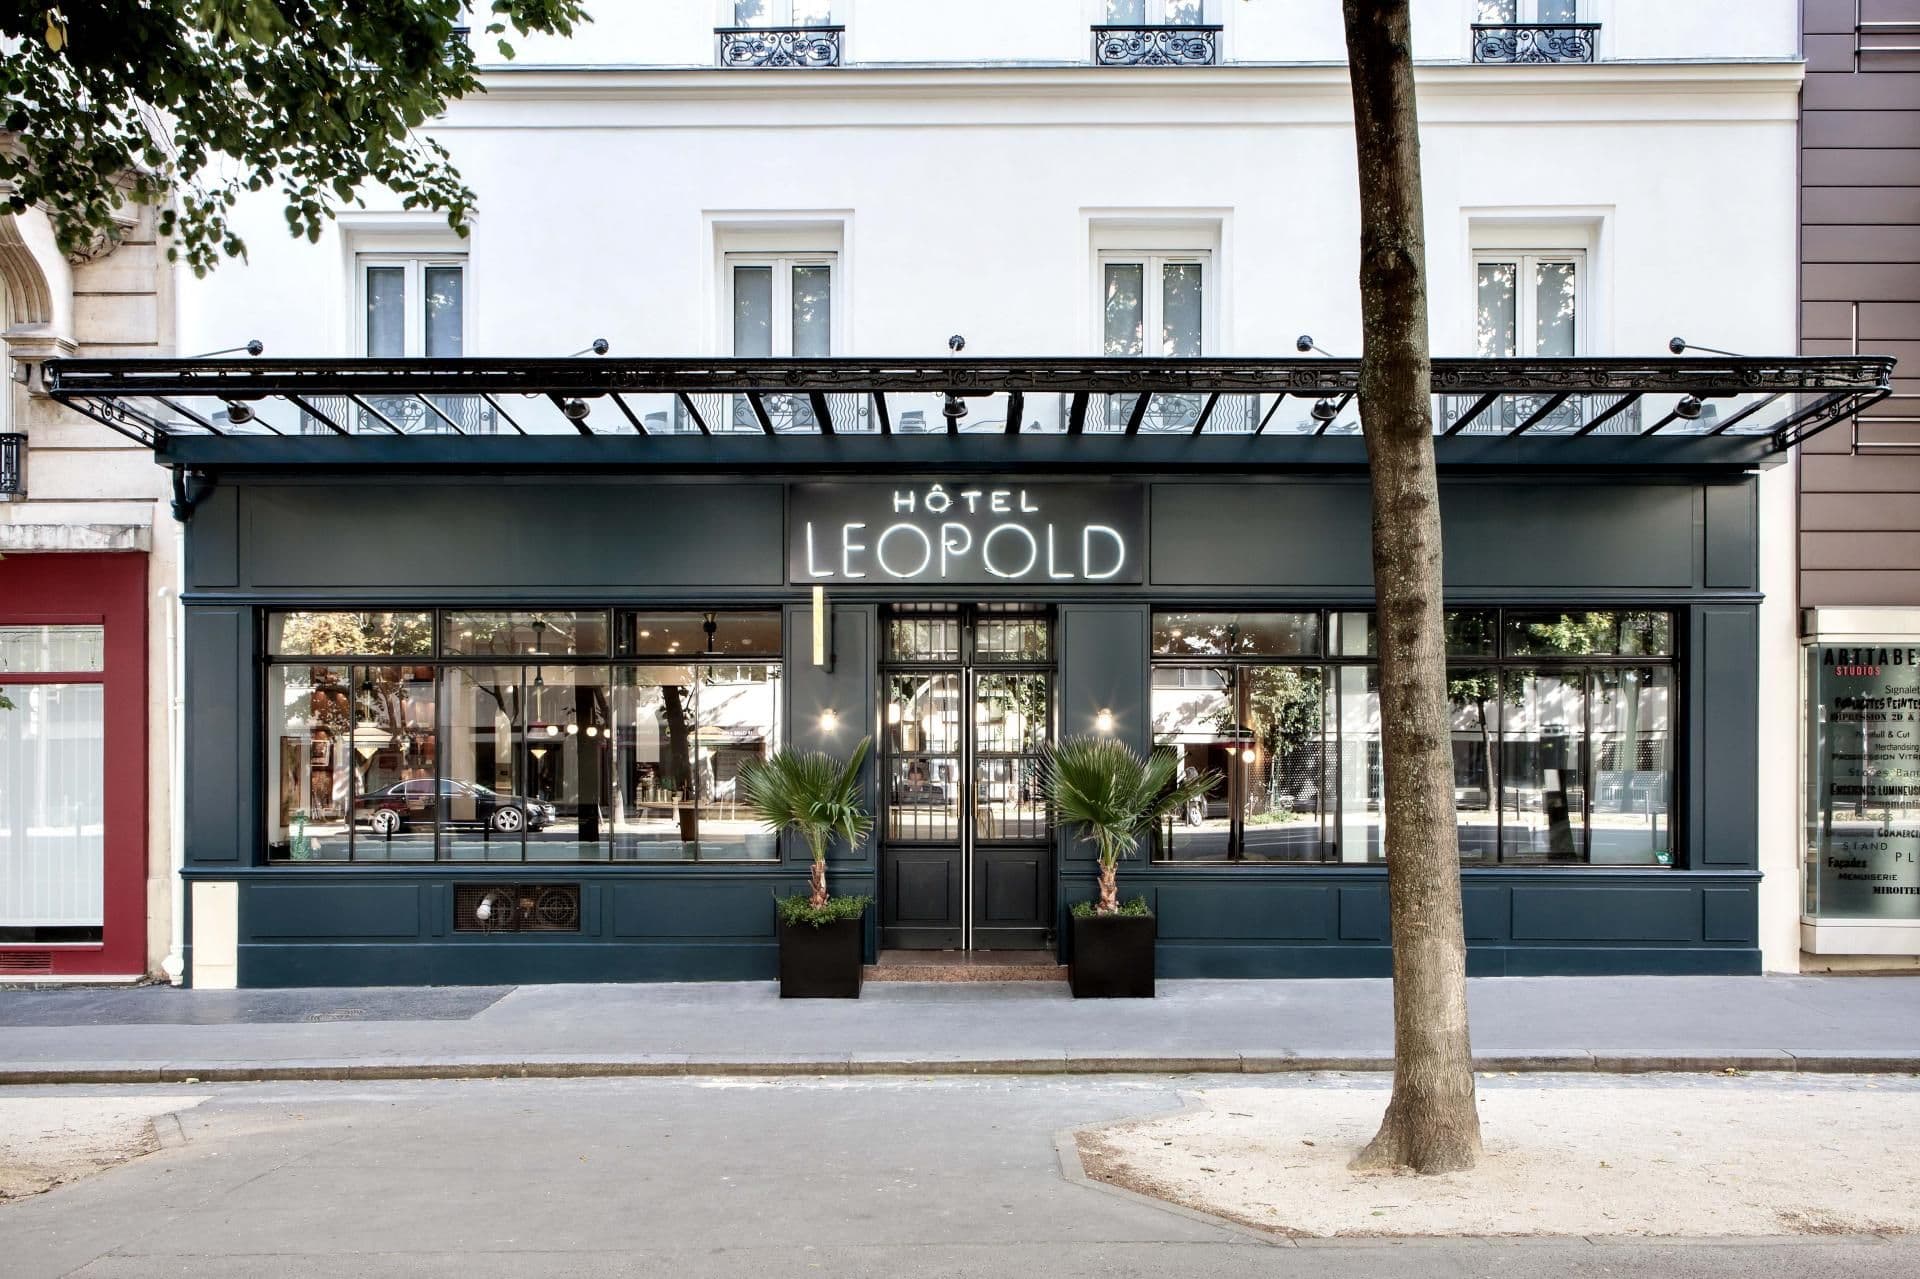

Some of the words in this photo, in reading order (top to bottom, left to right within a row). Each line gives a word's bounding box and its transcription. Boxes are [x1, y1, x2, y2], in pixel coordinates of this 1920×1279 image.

[893, 484, 1038, 513] HÔTEL
[806, 521, 1126, 578] LEOPOLD
[1836, 666, 1880, 676] STUDIOS
[1843, 842, 1888, 850] STAND
